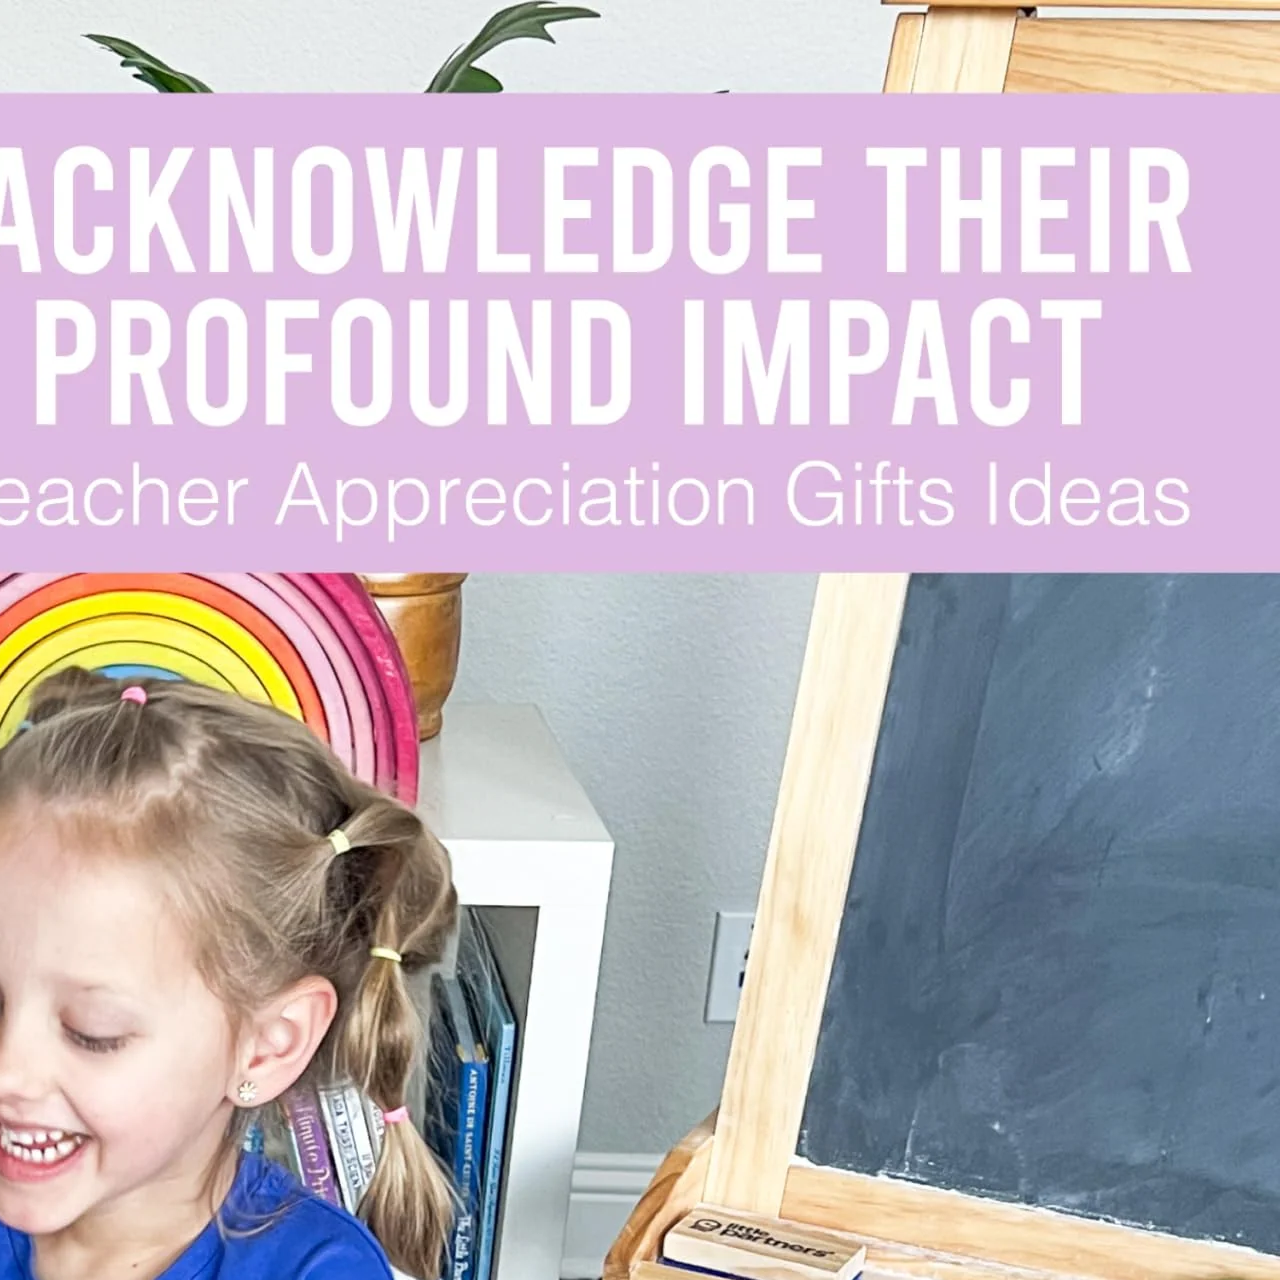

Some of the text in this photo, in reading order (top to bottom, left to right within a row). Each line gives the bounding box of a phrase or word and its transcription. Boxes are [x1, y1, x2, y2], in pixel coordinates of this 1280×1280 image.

[467, 1068, 478, 1114] ANTOINE
[465, 1116, 475, 1129] DE
[308, 1167, 331, 1194] Pri
[346, 1154, 363, 1187] SCIEN
[720, 1222, 831, 1258] little partners
